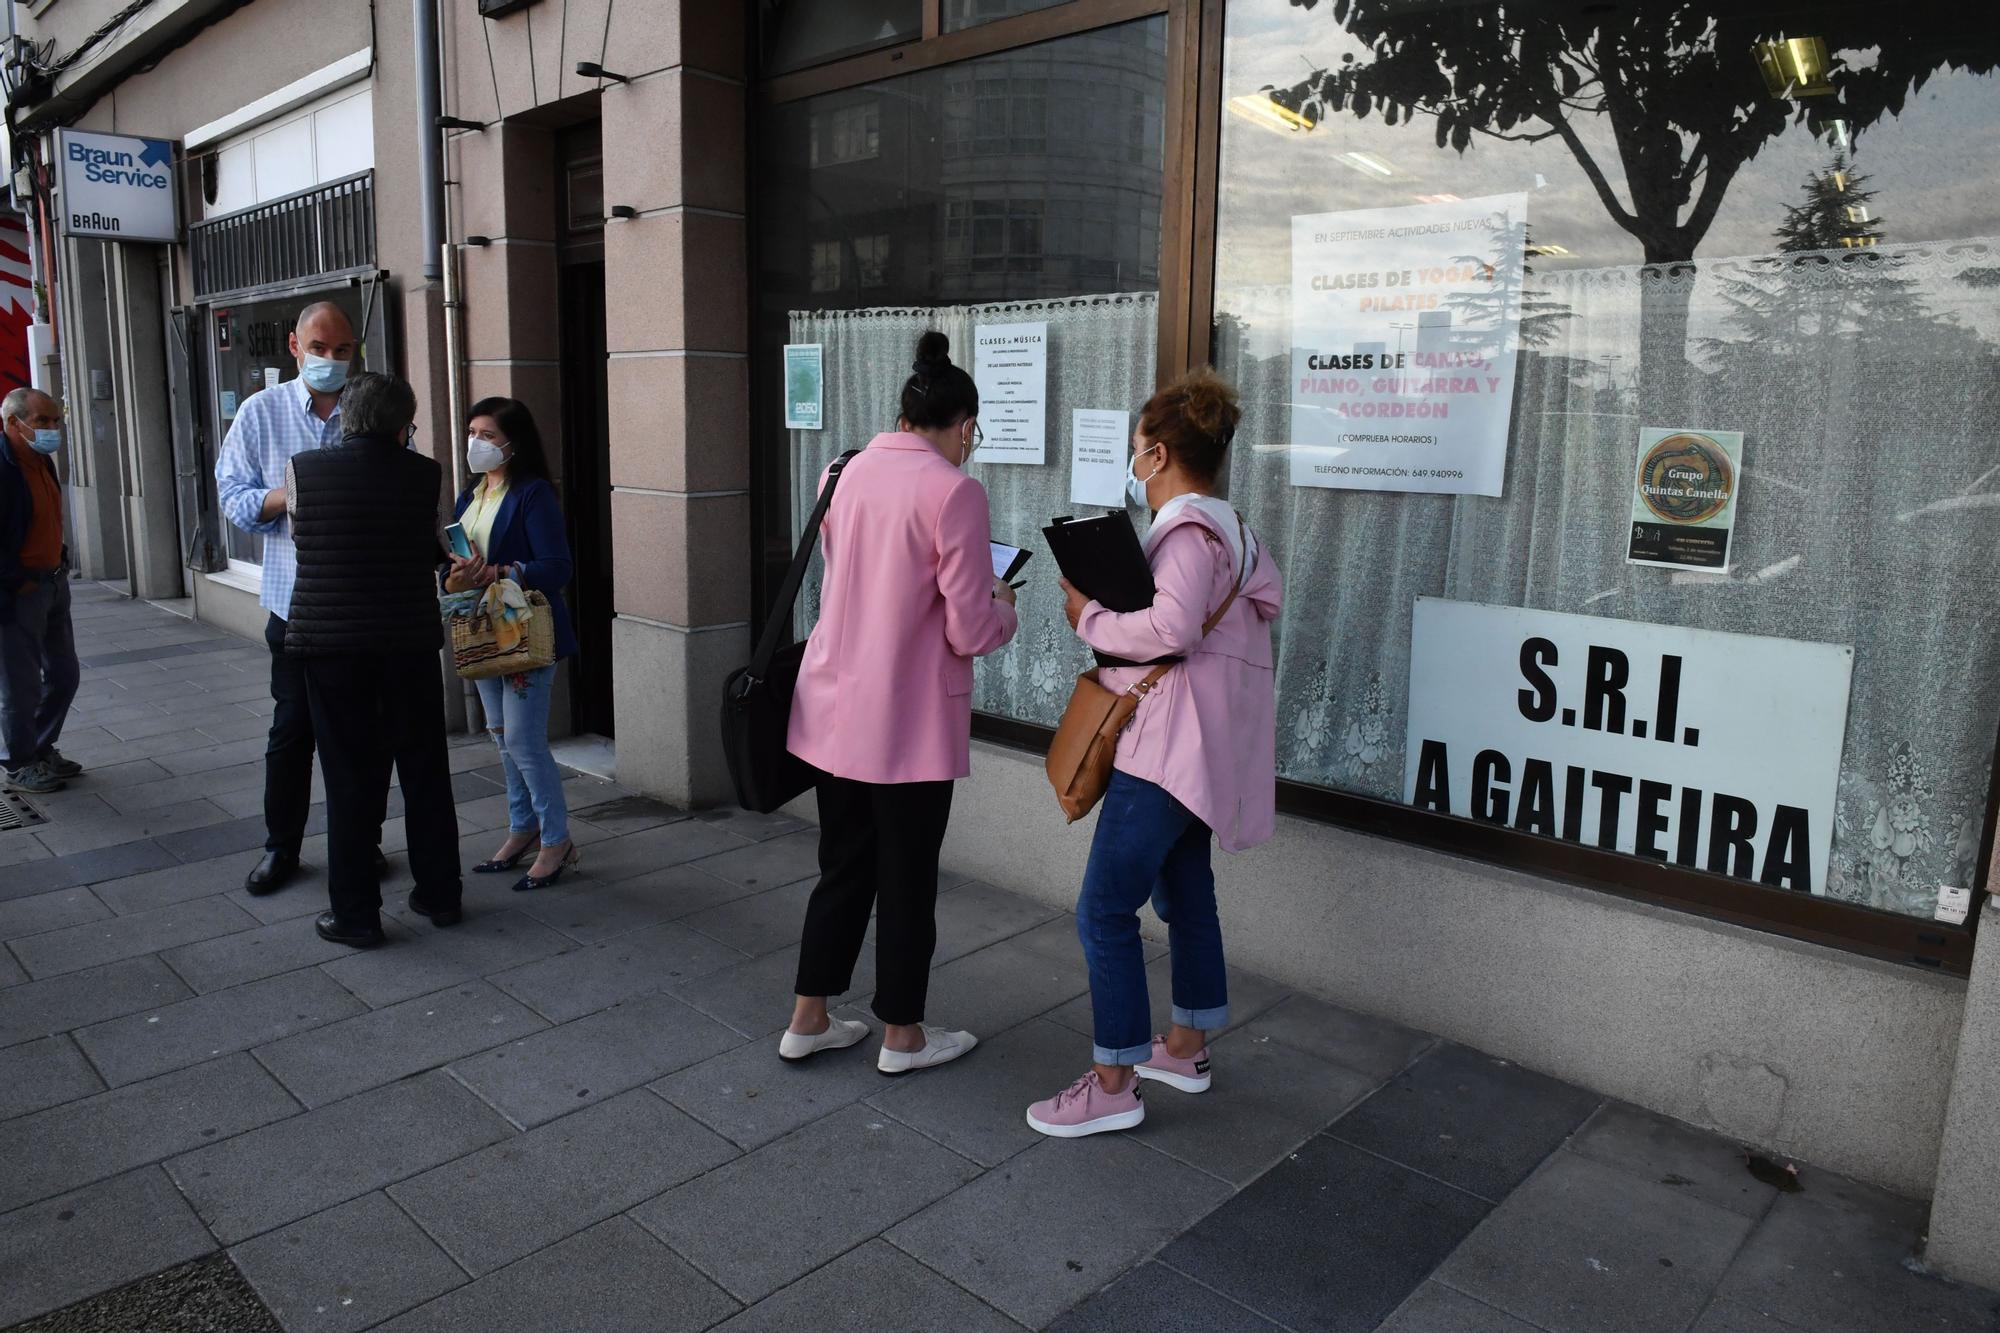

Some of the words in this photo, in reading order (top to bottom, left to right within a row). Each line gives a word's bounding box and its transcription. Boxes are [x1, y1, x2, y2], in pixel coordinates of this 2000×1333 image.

[68, 142, 133, 168] Braun
[85, 162, 168, 189] Service
[1314, 233, 1328, 243] EN
[1329, 228, 1386, 242] SEPTIEMBRE
[1387, 222, 1451, 239] ACTIVIDADES
[1310, 272, 1379, 291] CLASES
[1385, 271, 1411, 287] DE
[1417, 265, 1477, 286] YOGA
[1359, 293, 1438, 313] PILATES
[980, 337, 1006, 346] CLASES
[1013, 336, 1042, 344] MÚSICA
[1308, 354, 1374, 370] CLASES
[1380, 354, 1405, 370] DE
[1300, 378, 1366, 396] PIANO,
[1486, 377, 1501, 393] Y
[1338, 398, 1449, 419] ACORDEÓN
[1342, 434, 1390, 443] COMPRUEBA
[1391, 434, 1432, 444] HORARIOS
[1351, 465, 1410, 477] INFORMACIÓN:
[1411, 469, 1464, 479] 649.940996
[1668, 469, 1704, 481] Grupo
[1641, 484, 1684, 497] Quintas
[1686, 487, 1729, 500] Canella
[1517, 636, 1700, 747] S.R.I.
[1413, 739, 1451, 814] A
[1470, 748, 1812, 893] GAITEIRA
